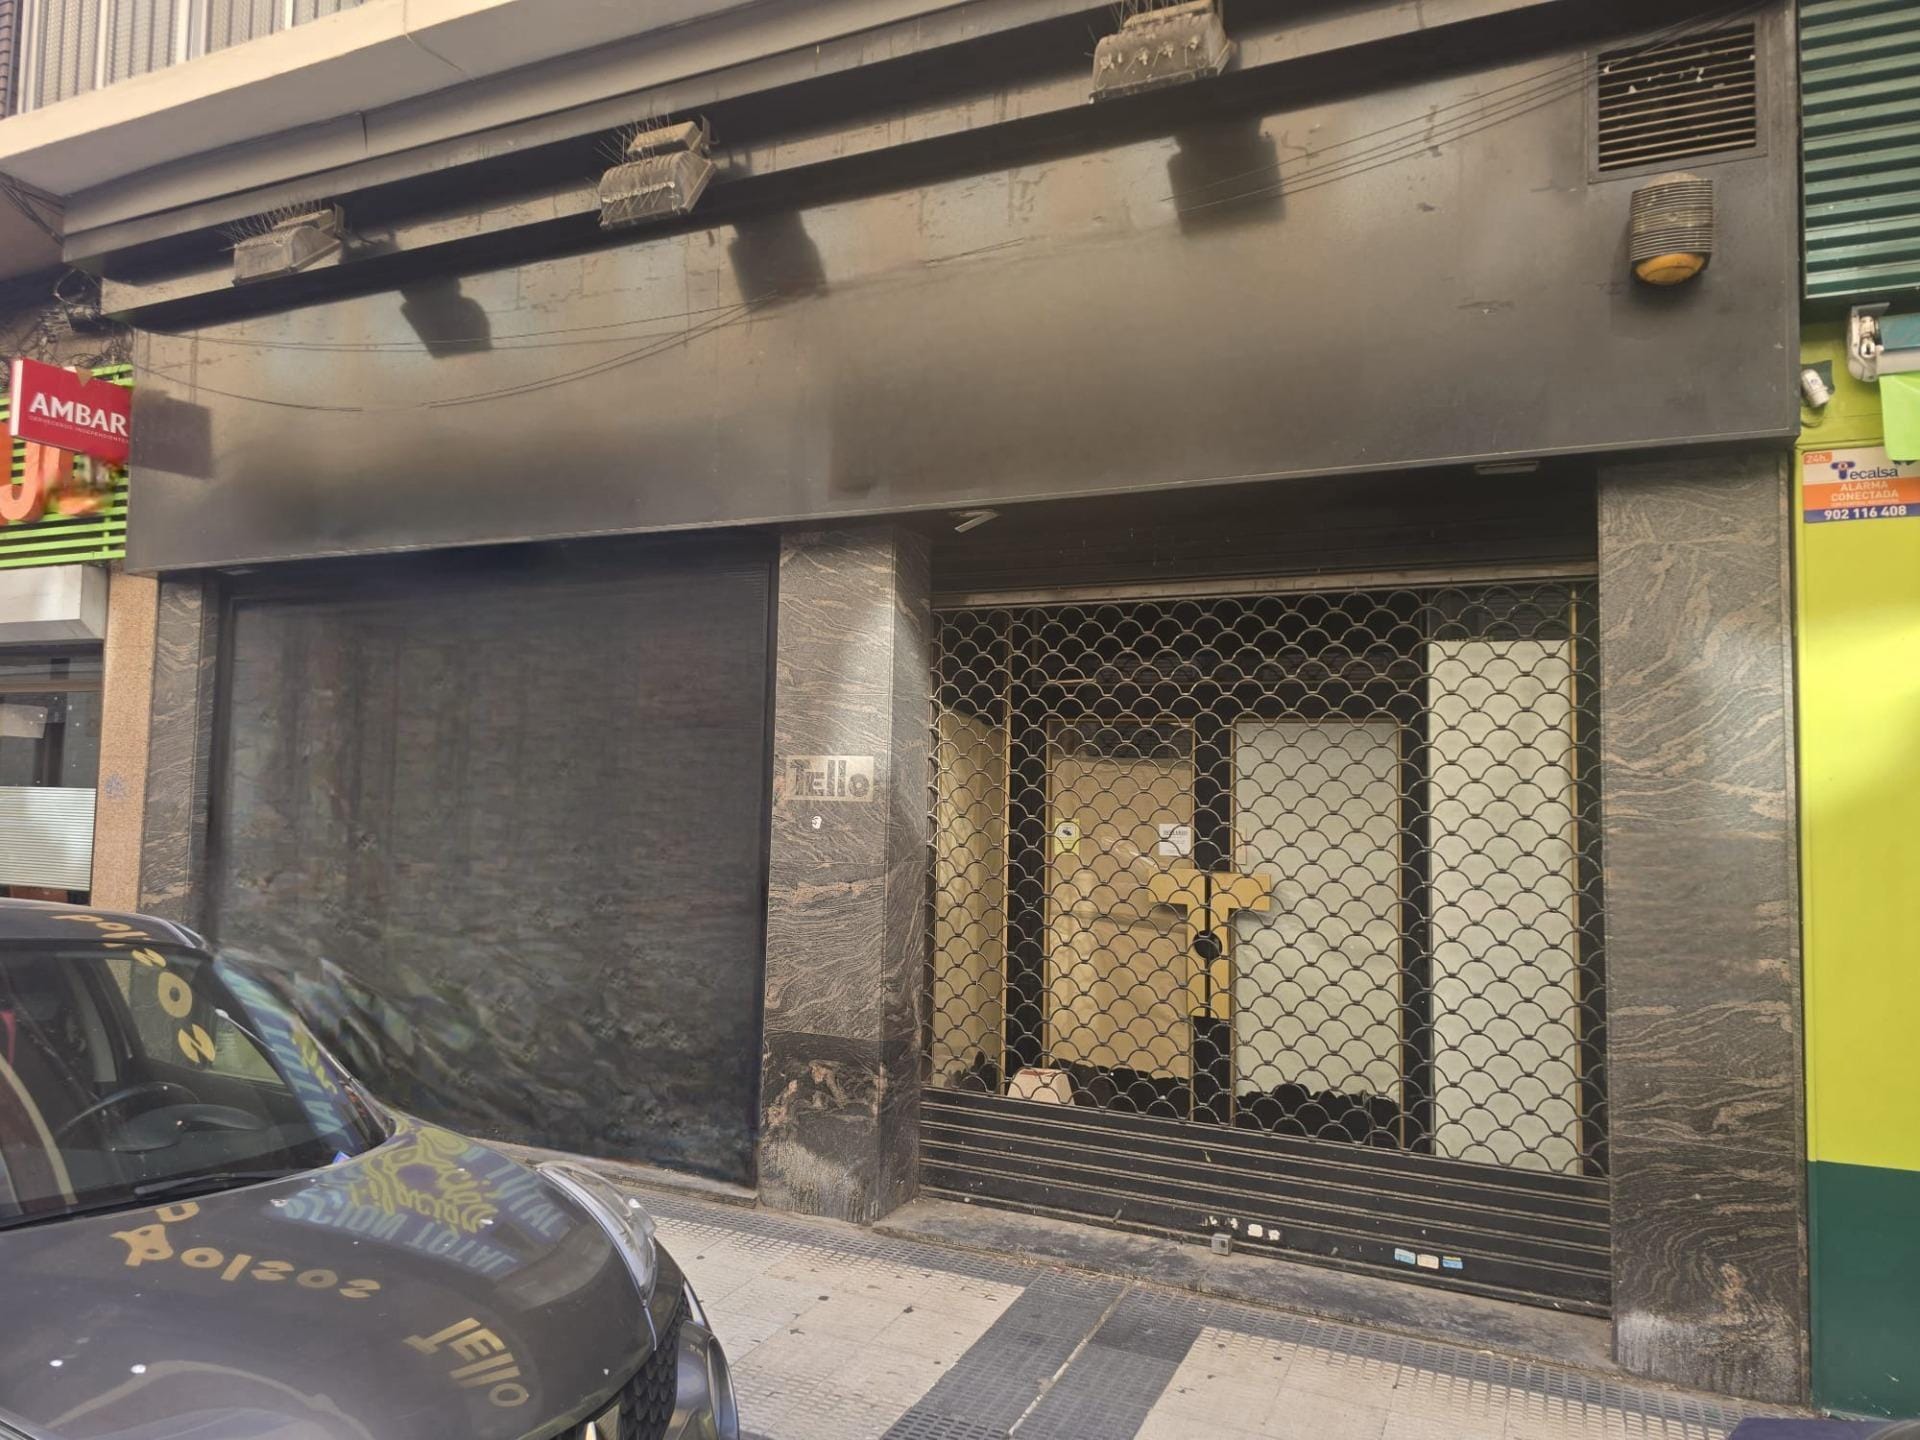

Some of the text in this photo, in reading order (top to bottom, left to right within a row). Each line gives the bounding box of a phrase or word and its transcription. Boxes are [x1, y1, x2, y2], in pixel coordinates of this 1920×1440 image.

[29, 392, 128, 437] AMBAR
[1830, 461, 1898, 480] Tecalsa
[1840, 481, 1888, 491] ALARMA
[1831, 490, 1899, 501] CONECTADA
[1824, 505, 1907, 520] 902 116 408
